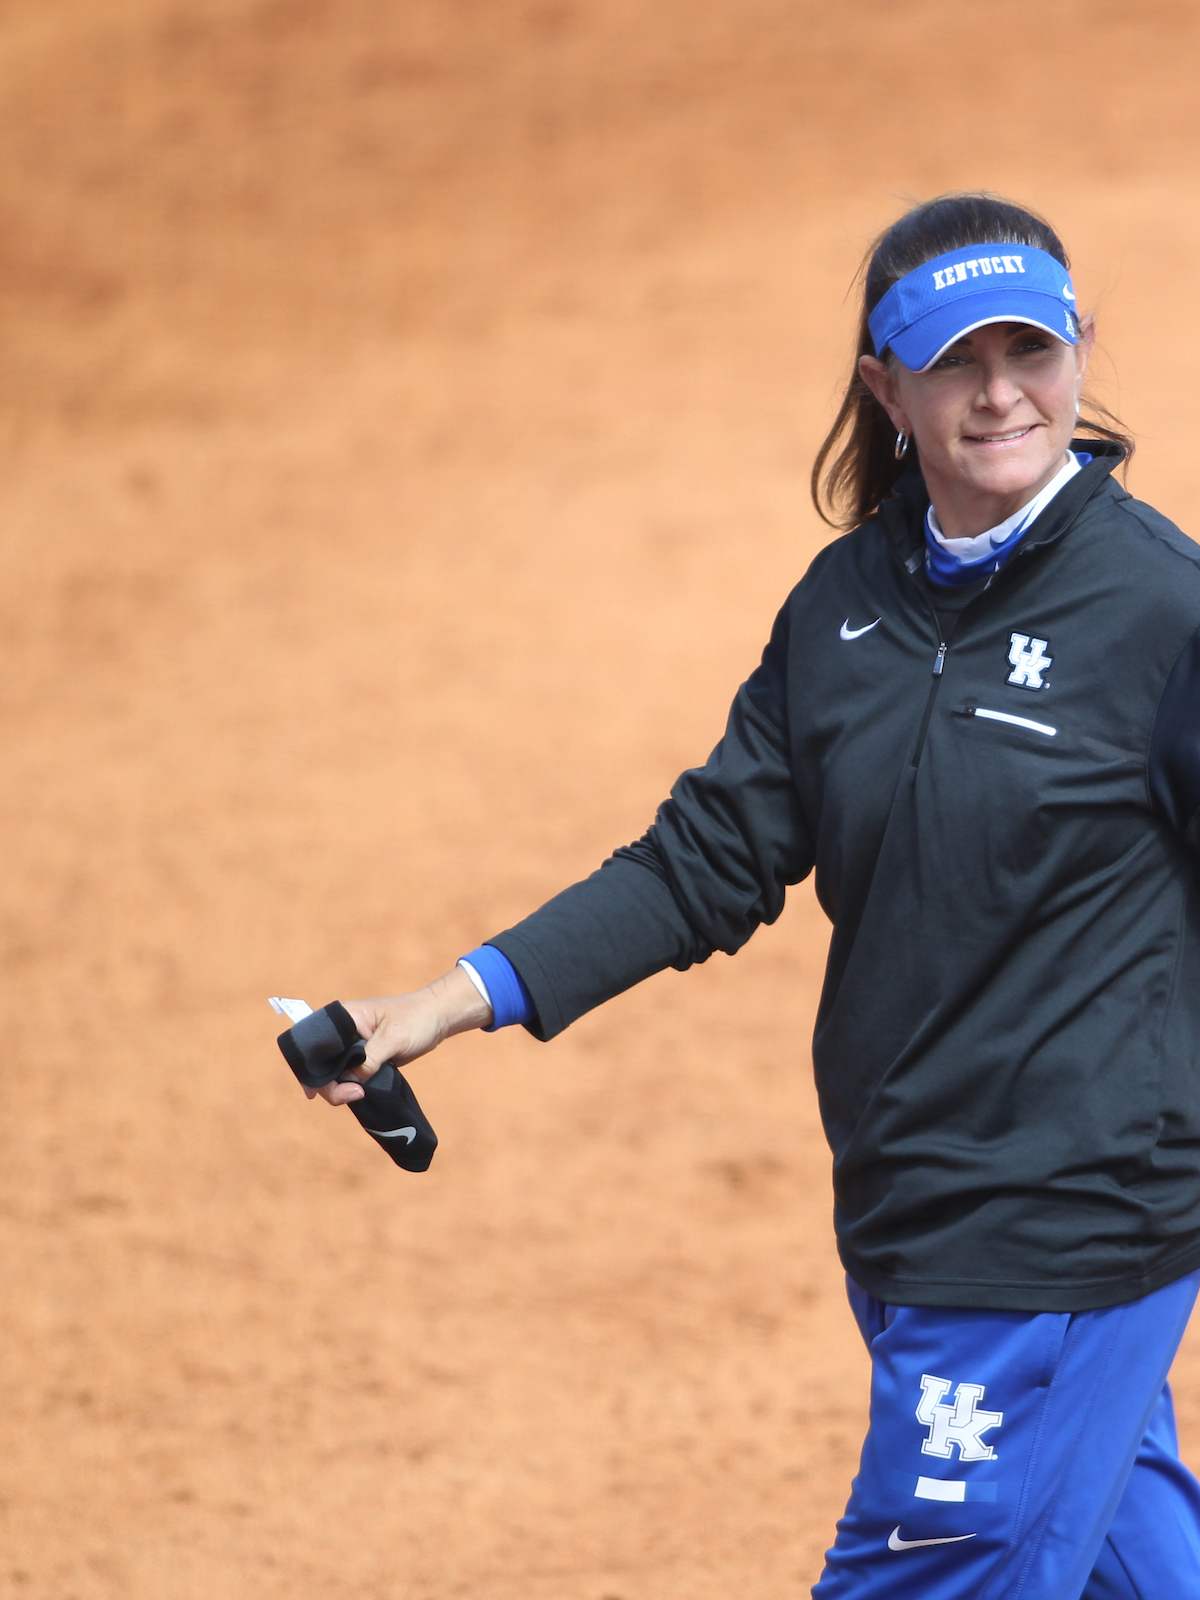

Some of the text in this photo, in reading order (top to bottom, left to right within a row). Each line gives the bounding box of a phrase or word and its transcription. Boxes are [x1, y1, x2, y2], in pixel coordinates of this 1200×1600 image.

[932, 255, 1026, 291] KENTUCKY
[1007, 632, 1053, 689] UK
[915, 1374, 1004, 1462] UK
